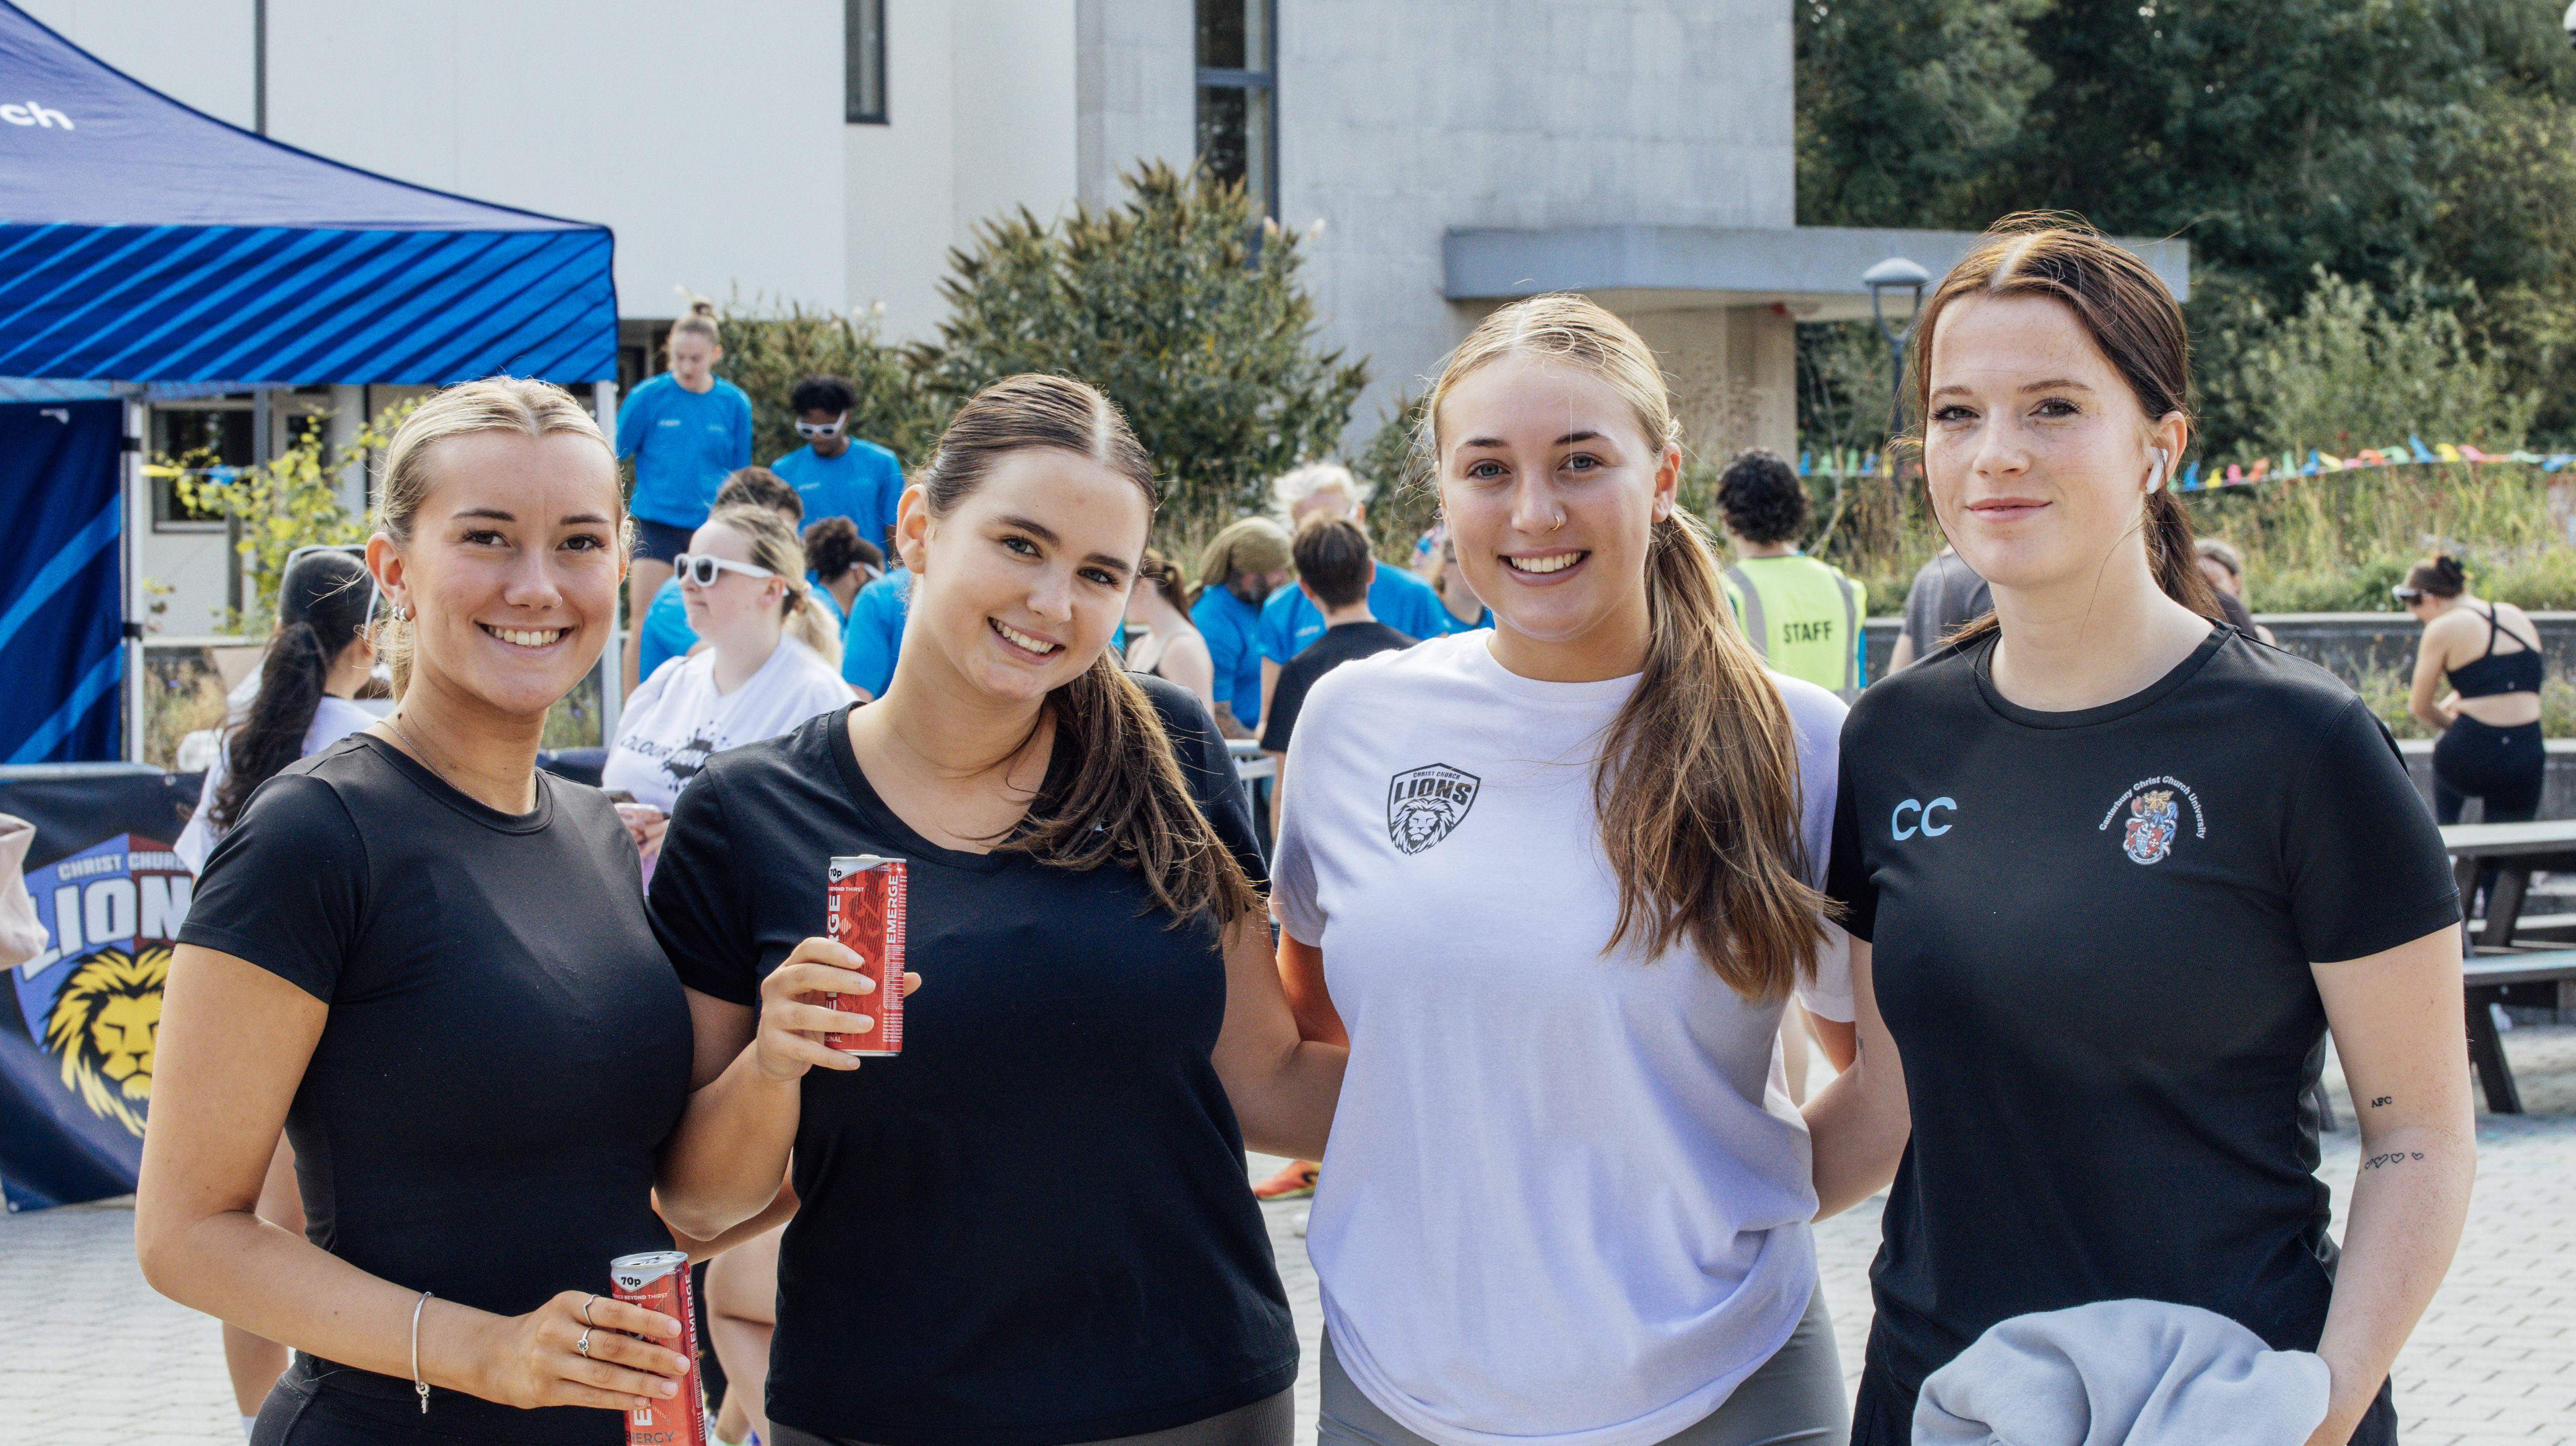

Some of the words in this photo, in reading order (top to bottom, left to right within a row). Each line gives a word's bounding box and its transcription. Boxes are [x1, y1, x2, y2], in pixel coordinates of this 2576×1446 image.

[1783, 621, 1833, 643] STAFF
[1436, 771, 1461, 780] CHURCH
[1394, 778, 1473, 806] LIONS
[1892, 796, 1957, 841] CC
[2098, 789, 2132, 831] Canterbury
[2133, 776, 2160, 791] Christ
[2162, 776, 2192, 795] Church
[2188, 793, 2206, 839] University
[57, 854, 123, 881] CHRIST
[830, 868, 842, 879] 70p
[886, 875, 898, 943] EMERGE
[2371, 1096, 2392, 1108] AFC
[621, 1276, 641, 1287] 70p
[685, 1273, 697, 1342] EMERGE
